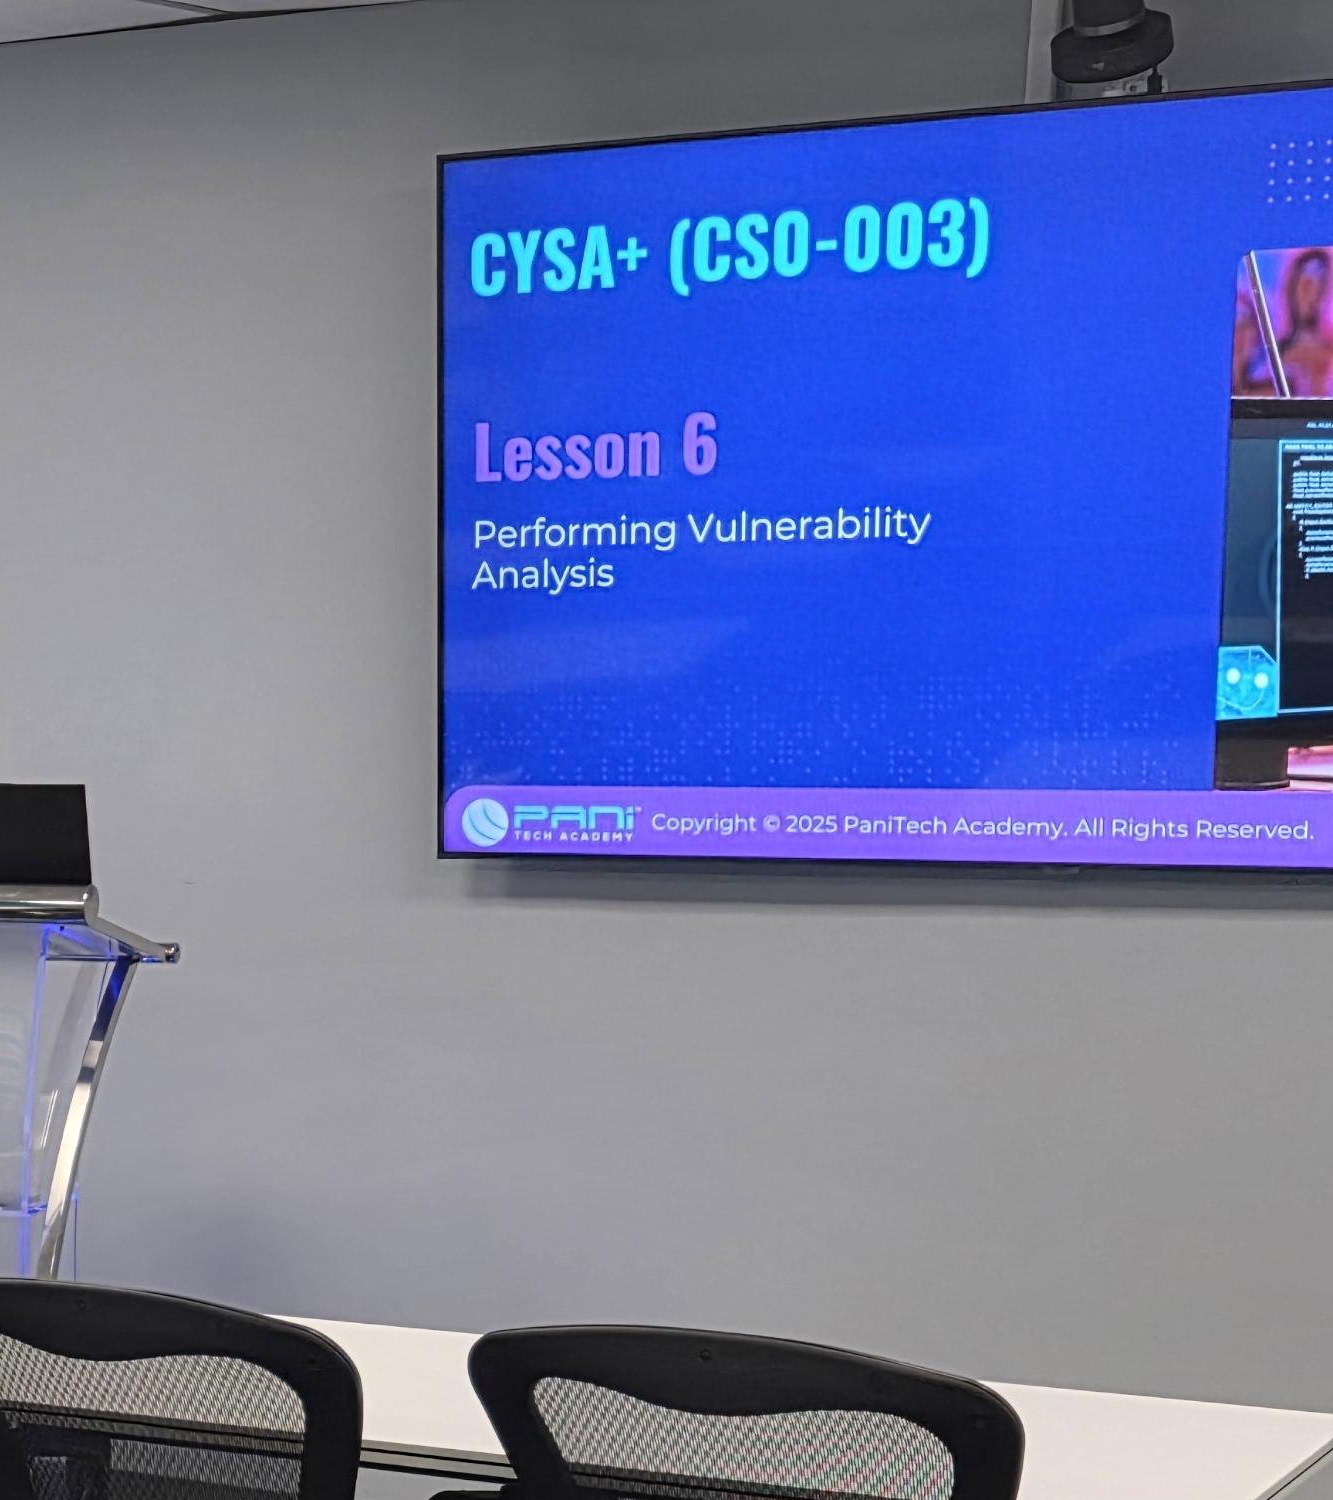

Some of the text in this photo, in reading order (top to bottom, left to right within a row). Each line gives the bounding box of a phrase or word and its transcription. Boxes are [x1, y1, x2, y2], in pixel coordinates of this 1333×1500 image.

[470, 223, 649, 297] CYSA+
[475, 411, 718, 483] Lesson 6
[473, 504, 933, 553] Performing Vulnerability
[471, 555, 616, 596] Analysis
[513, 830, 634, 842] TECH ACADEMY
[651, 813, 757, 836] Copyright
[785, 815, 838, 834] 2025
[844, 815, 947, 835] PaniTech
[952, 816, 1068, 840] Academy.
[1074, 816, 1105, 837] All
[1112, 817, 1189, 842] Rights
[1196, 819, 1316, 841] Reserved.
